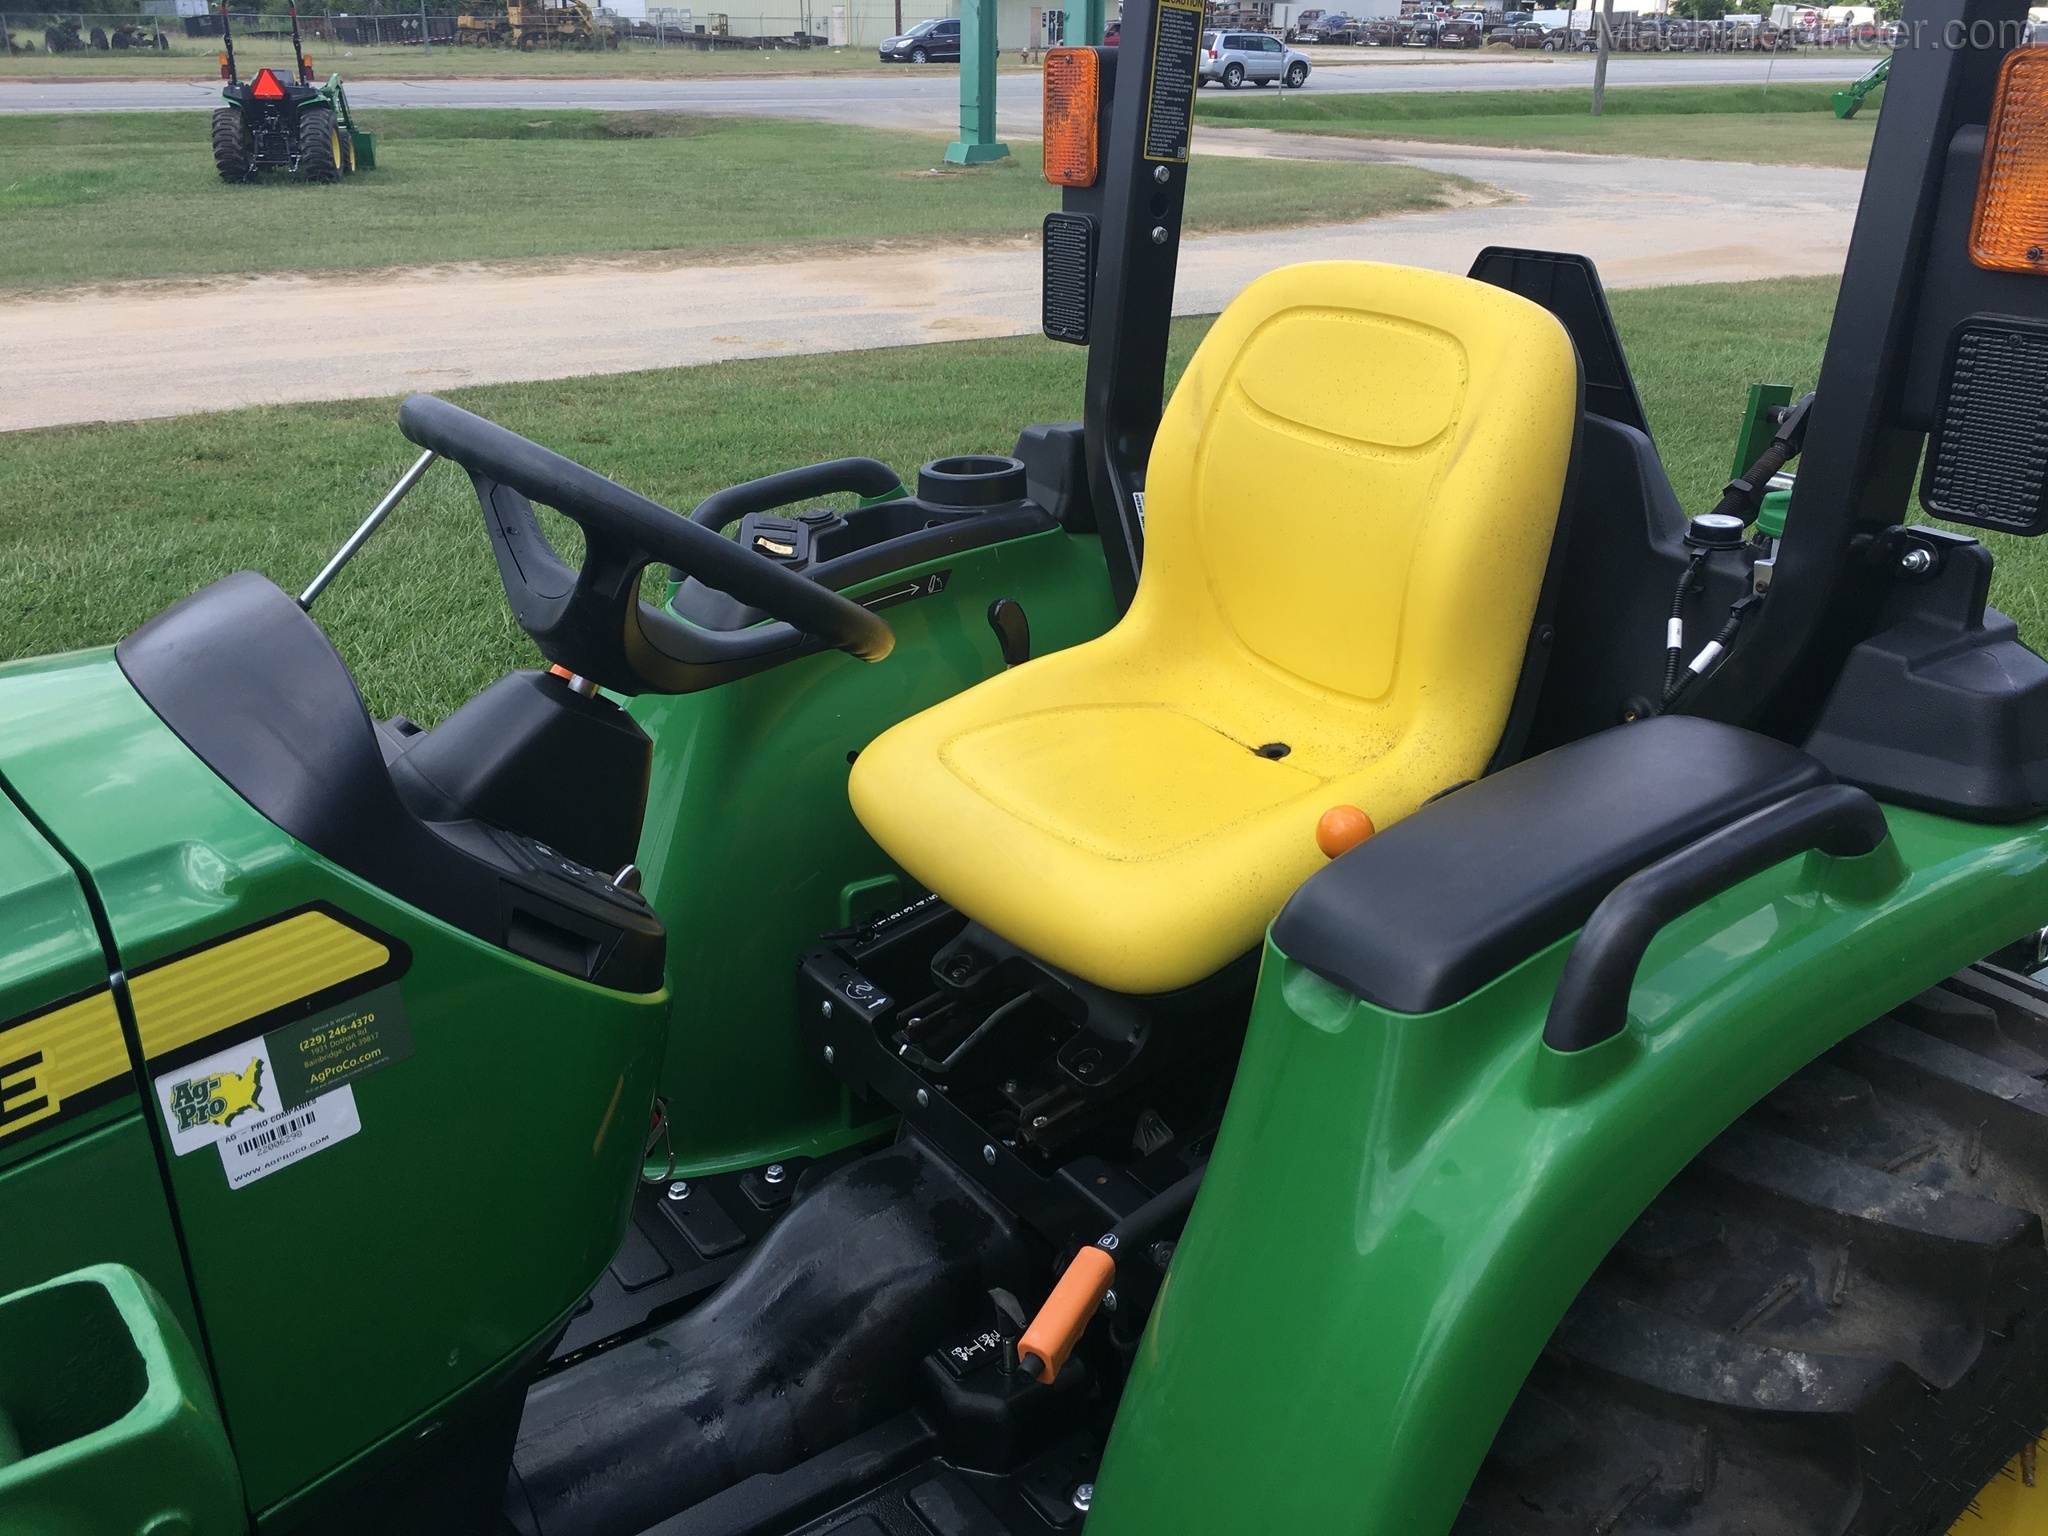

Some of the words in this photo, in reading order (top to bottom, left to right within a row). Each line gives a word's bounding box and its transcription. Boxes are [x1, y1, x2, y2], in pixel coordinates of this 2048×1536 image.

[1135, 494, 1143, 513] DEERE
[299, 1033, 327, 1052] (229)
[328, 1013, 376, 1040] 246-4370
[311, 1044, 329, 1056] 1931
[329, 1034, 357, 1049] Dothan
[356, 1027, 368, 1037] Rd
[345, 1042, 358, 1051] GA
[358, 1031, 379, 1047] 39817
[311, 1048, 382, 1084] AgProCo.com
[173, 1078, 220, 1109] Ag-
[177, 1098, 227, 1132] Pro
[225, 1133, 237, 1144] AG
[250, 1119, 269, 1132] PRO
[270, 1098, 317, 1123] COMPANIES
[256, 1130, 303, 1157] 22006298
